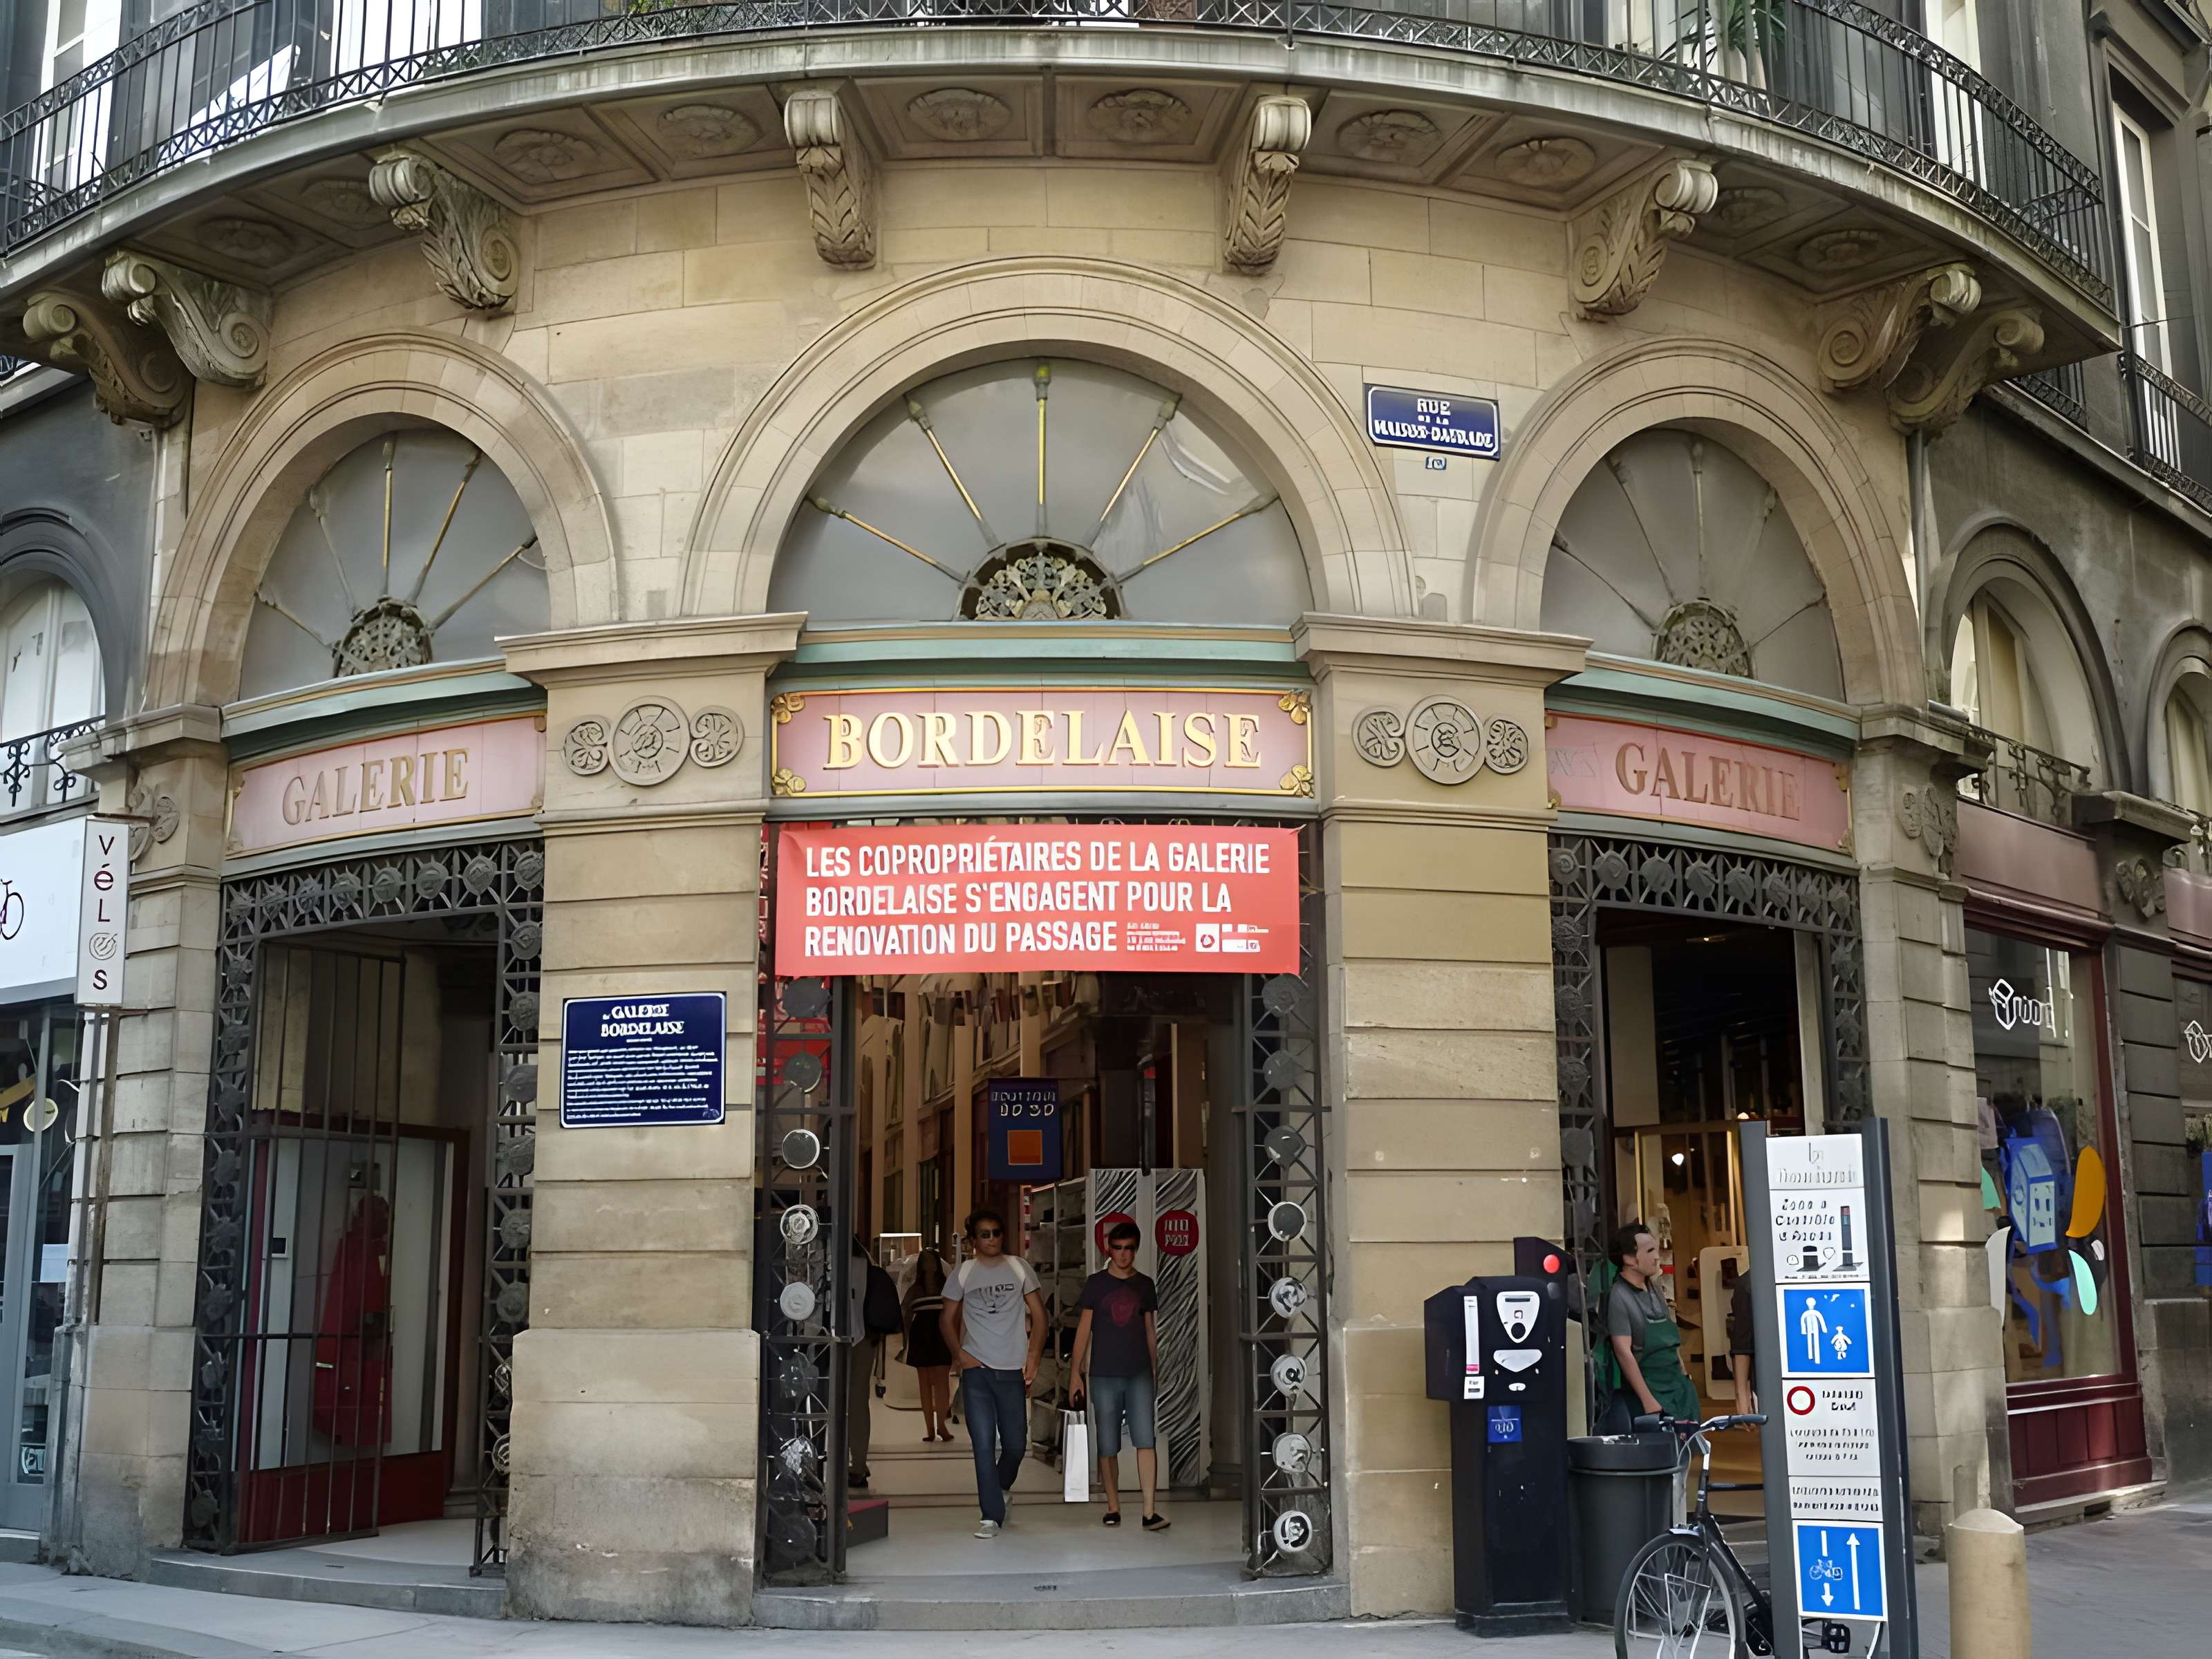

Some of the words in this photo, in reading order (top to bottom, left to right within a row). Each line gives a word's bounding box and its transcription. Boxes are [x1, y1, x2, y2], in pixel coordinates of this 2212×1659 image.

[1417, 398, 1451, 415] RUE
[823, 709, 1262, 770] BORDELAISE
[282, 747, 469, 825] GALERIE
[1615, 742, 1801, 821] GALERIE
[806, 846, 851, 877] LES
[859, 835, 1082, 876] COPROPRIÉTAIRES
[1090, 841, 1121, 871] DE
[1130, 841, 1161, 872] LA
[1168, 843, 1271, 874] GALERIE
[806, 883, 958, 917] BORDELAISE
[965, 881, 1121, 913] S'ENGAGENT
[1127, 881, 1193, 912] POUR
[1202, 882, 1232, 912] LA
[805, 924, 956, 957] RENOVATION
[964, 922, 997, 953] DU
[1006, 921, 1118, 953] PASSAGE
